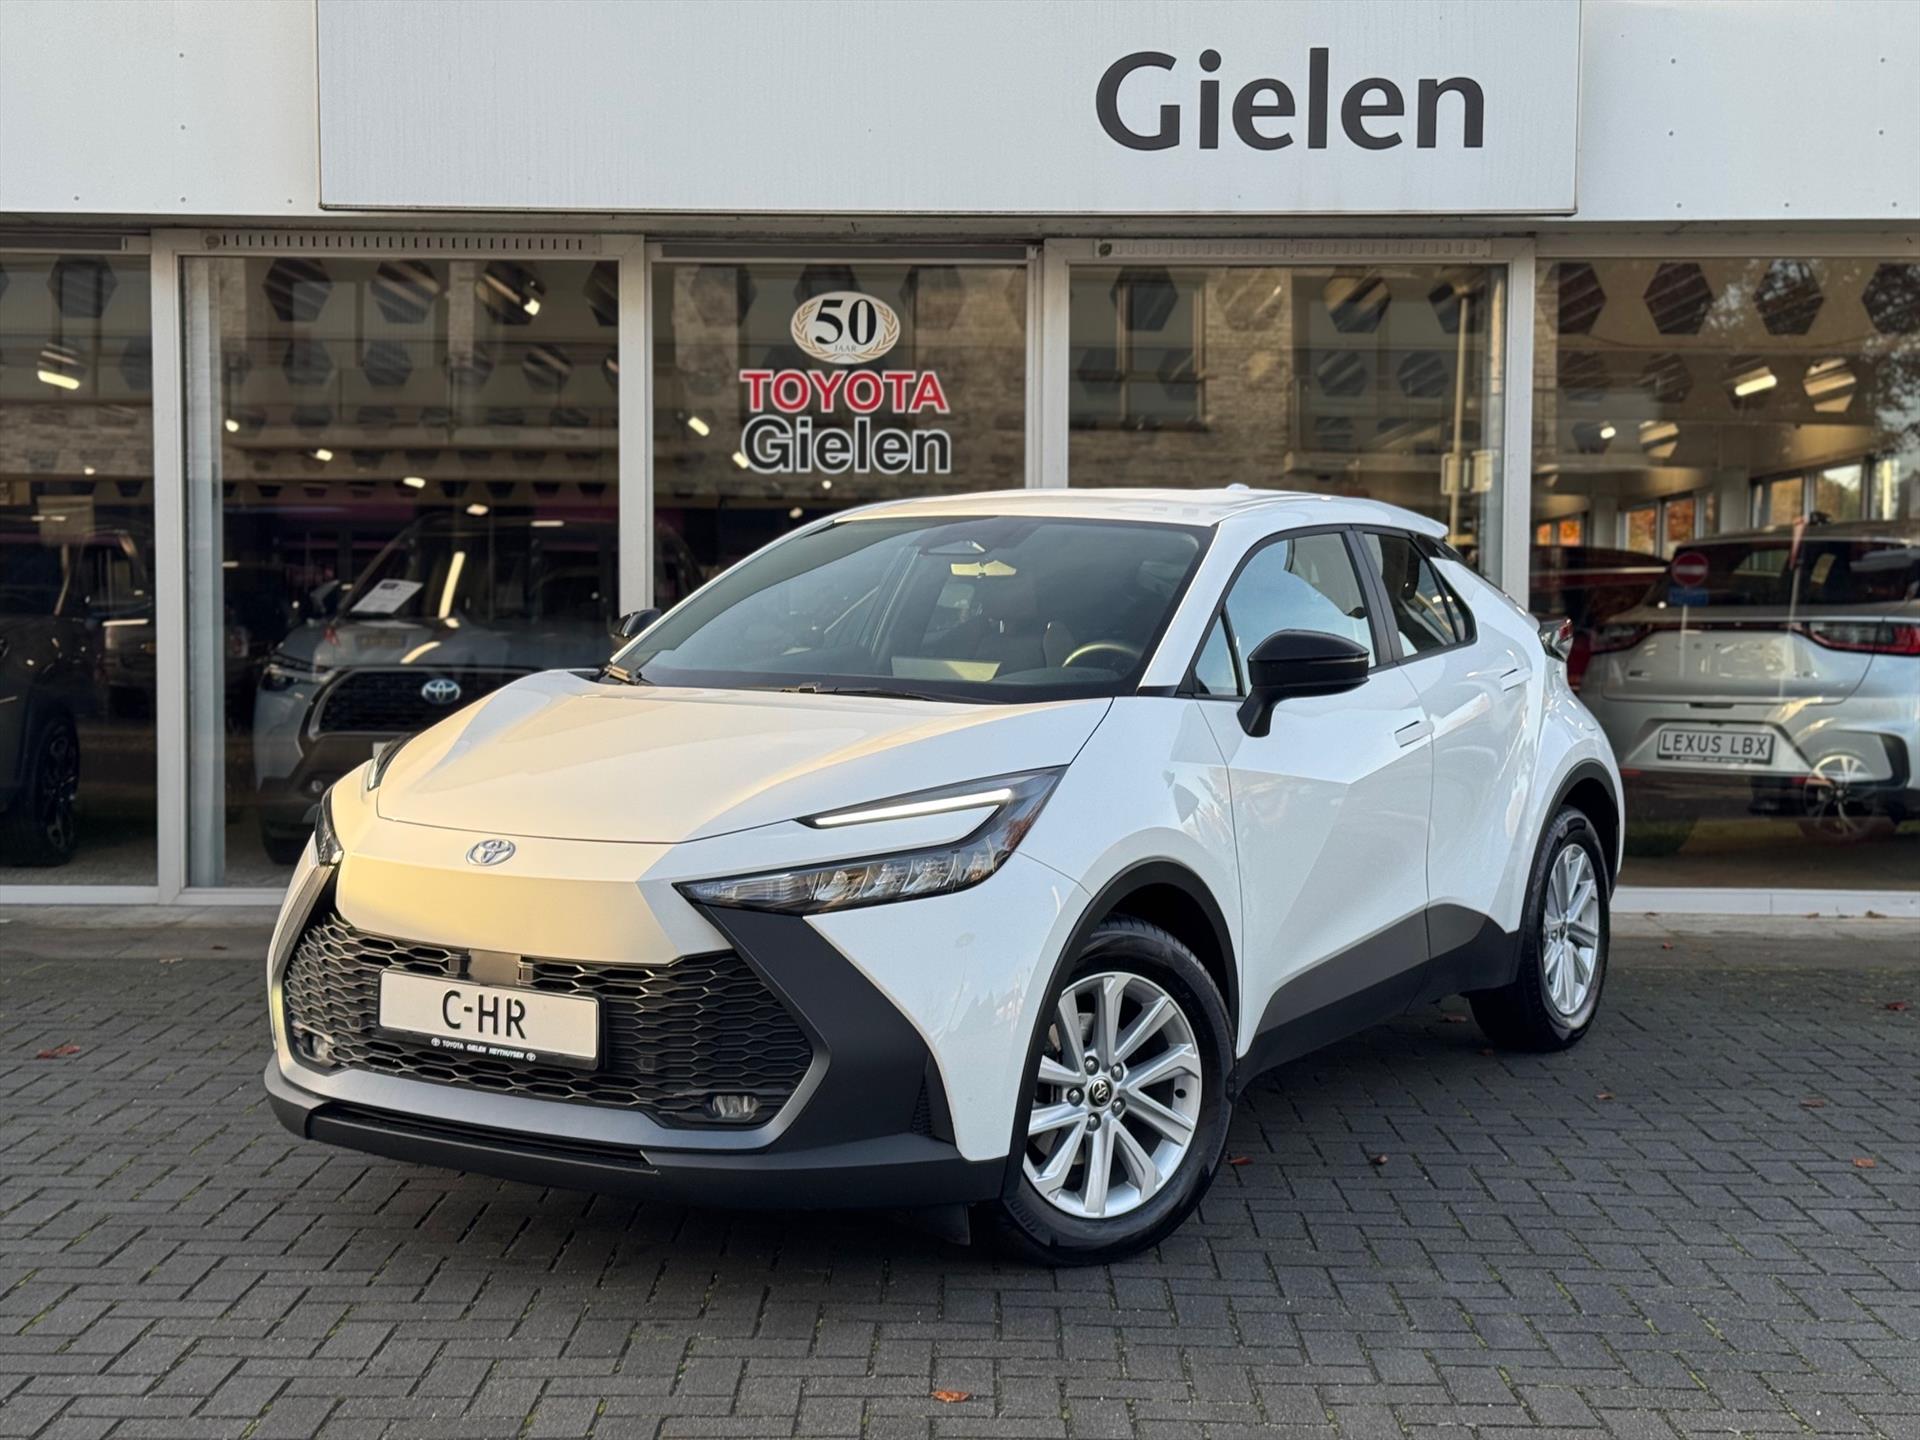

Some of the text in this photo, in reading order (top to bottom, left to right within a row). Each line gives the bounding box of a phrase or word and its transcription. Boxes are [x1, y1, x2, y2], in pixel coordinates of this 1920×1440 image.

[1095, 47, 1485, 151] Gielen
[814, 298, 877, 345] 50
[739, 369, 950, 413] TOYOTA
[741, 414, 952, 474] Gielen
[1661, 732, 1767, 756] LEXUS LBX
[442, 989, 527, 1040] C-HR
[442, 1039, 464, 1050] TOYOTA
